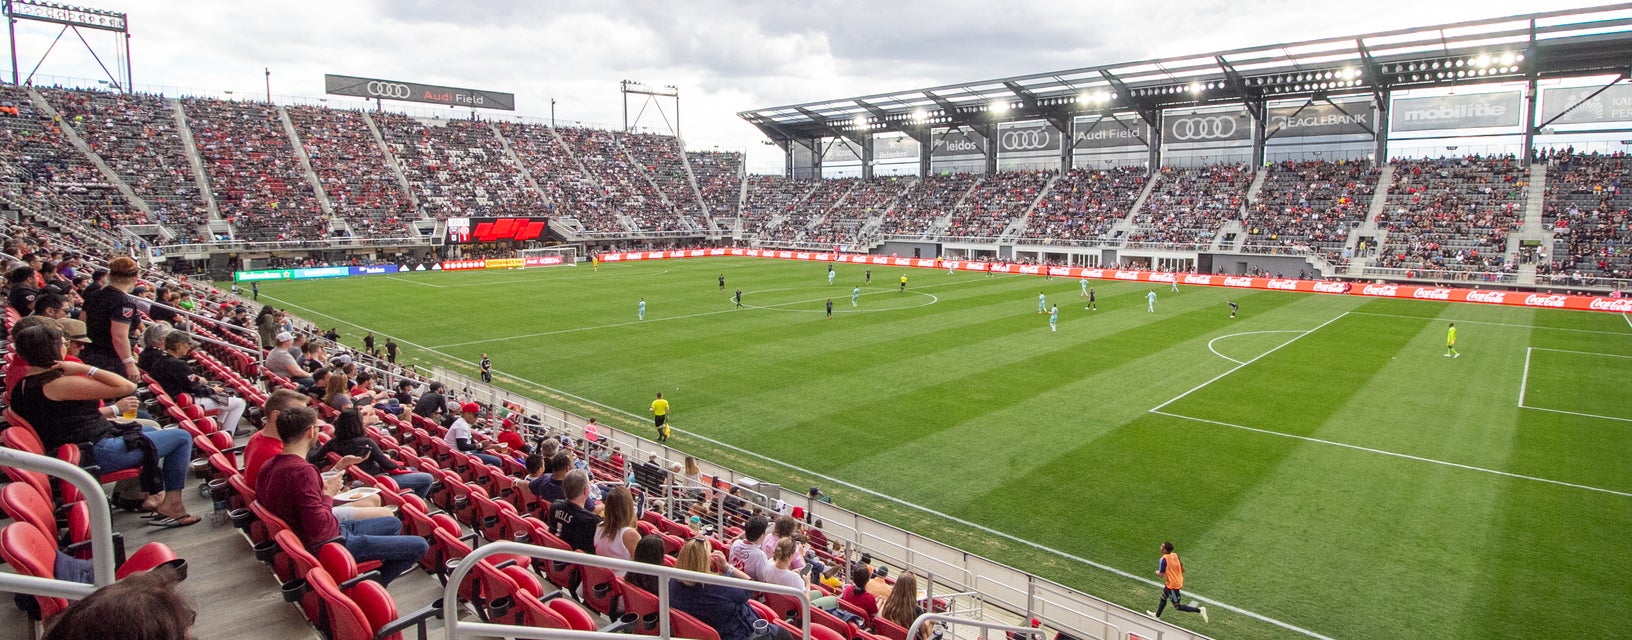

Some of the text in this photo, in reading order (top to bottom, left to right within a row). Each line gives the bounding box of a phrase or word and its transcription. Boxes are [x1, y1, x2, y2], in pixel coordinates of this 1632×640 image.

[424, 91, 484, 105] Audi Field
[1404, 103, 1507, 121] mobilitie
[1077, 127, 1140, 141] Audi Field
[946, 139, 977, 151] leidos
